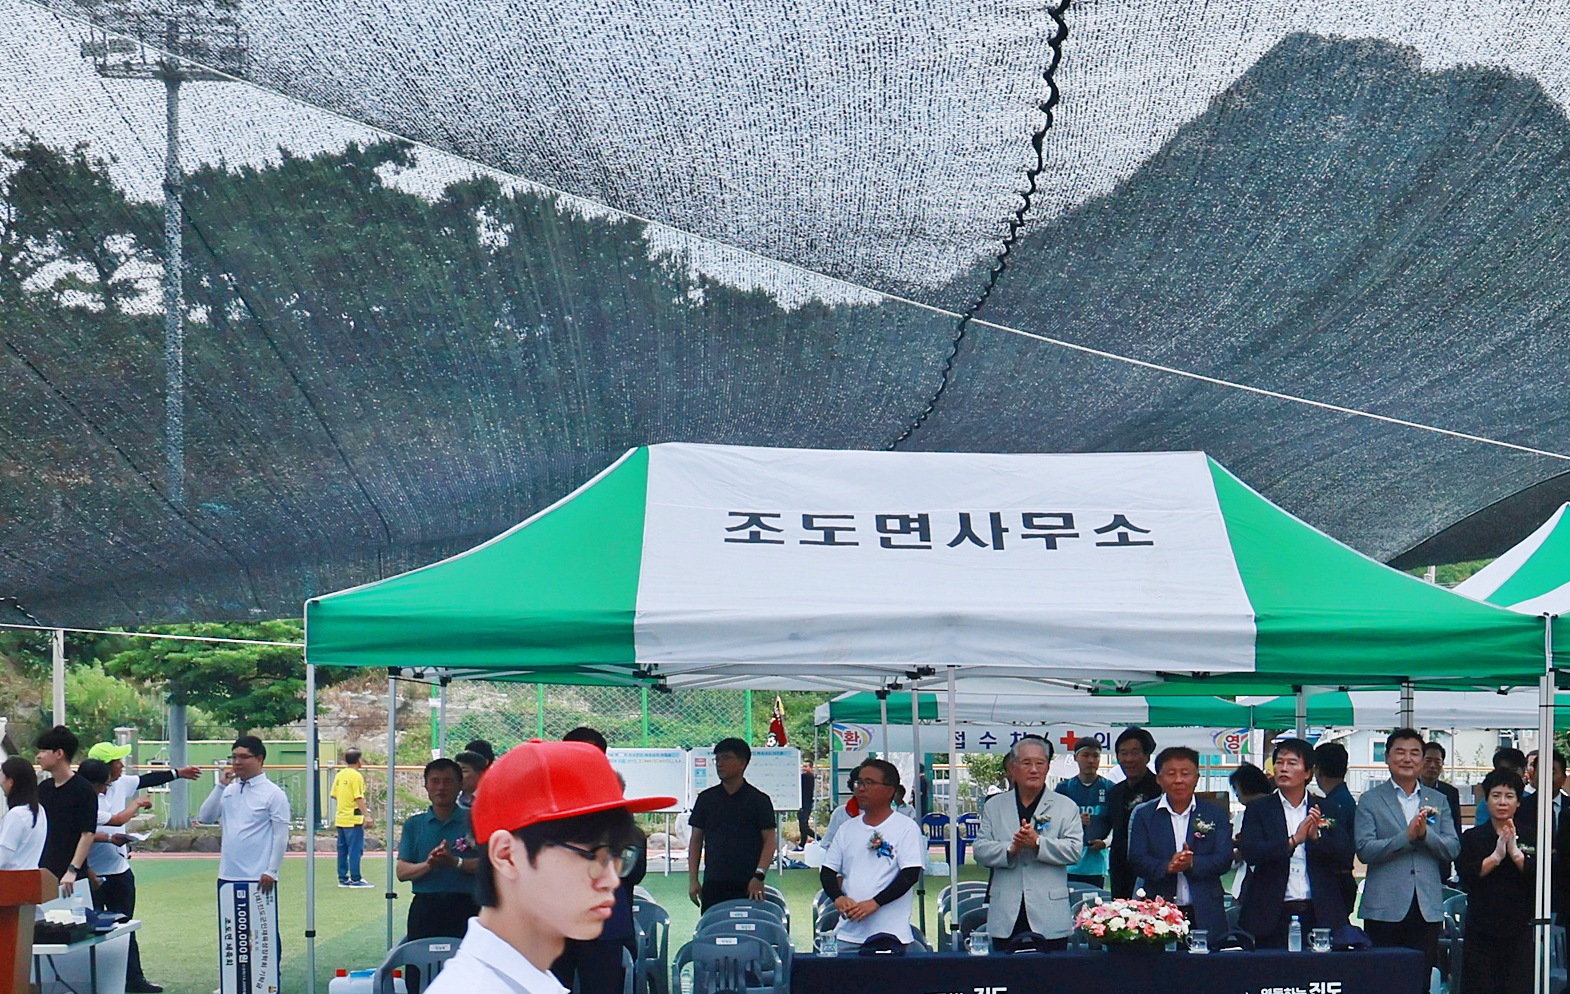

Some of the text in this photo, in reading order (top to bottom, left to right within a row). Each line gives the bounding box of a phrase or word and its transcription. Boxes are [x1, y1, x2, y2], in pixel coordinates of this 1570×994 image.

[724, 511, 1154, 550] 조도면사무소
[1226, 734, 1240, 750] 영
[236, 889, 246, 899] 금
[224, 917, 234, 966] 조도면 체육회
[237, 902, 248, 963] 1,000,000원
